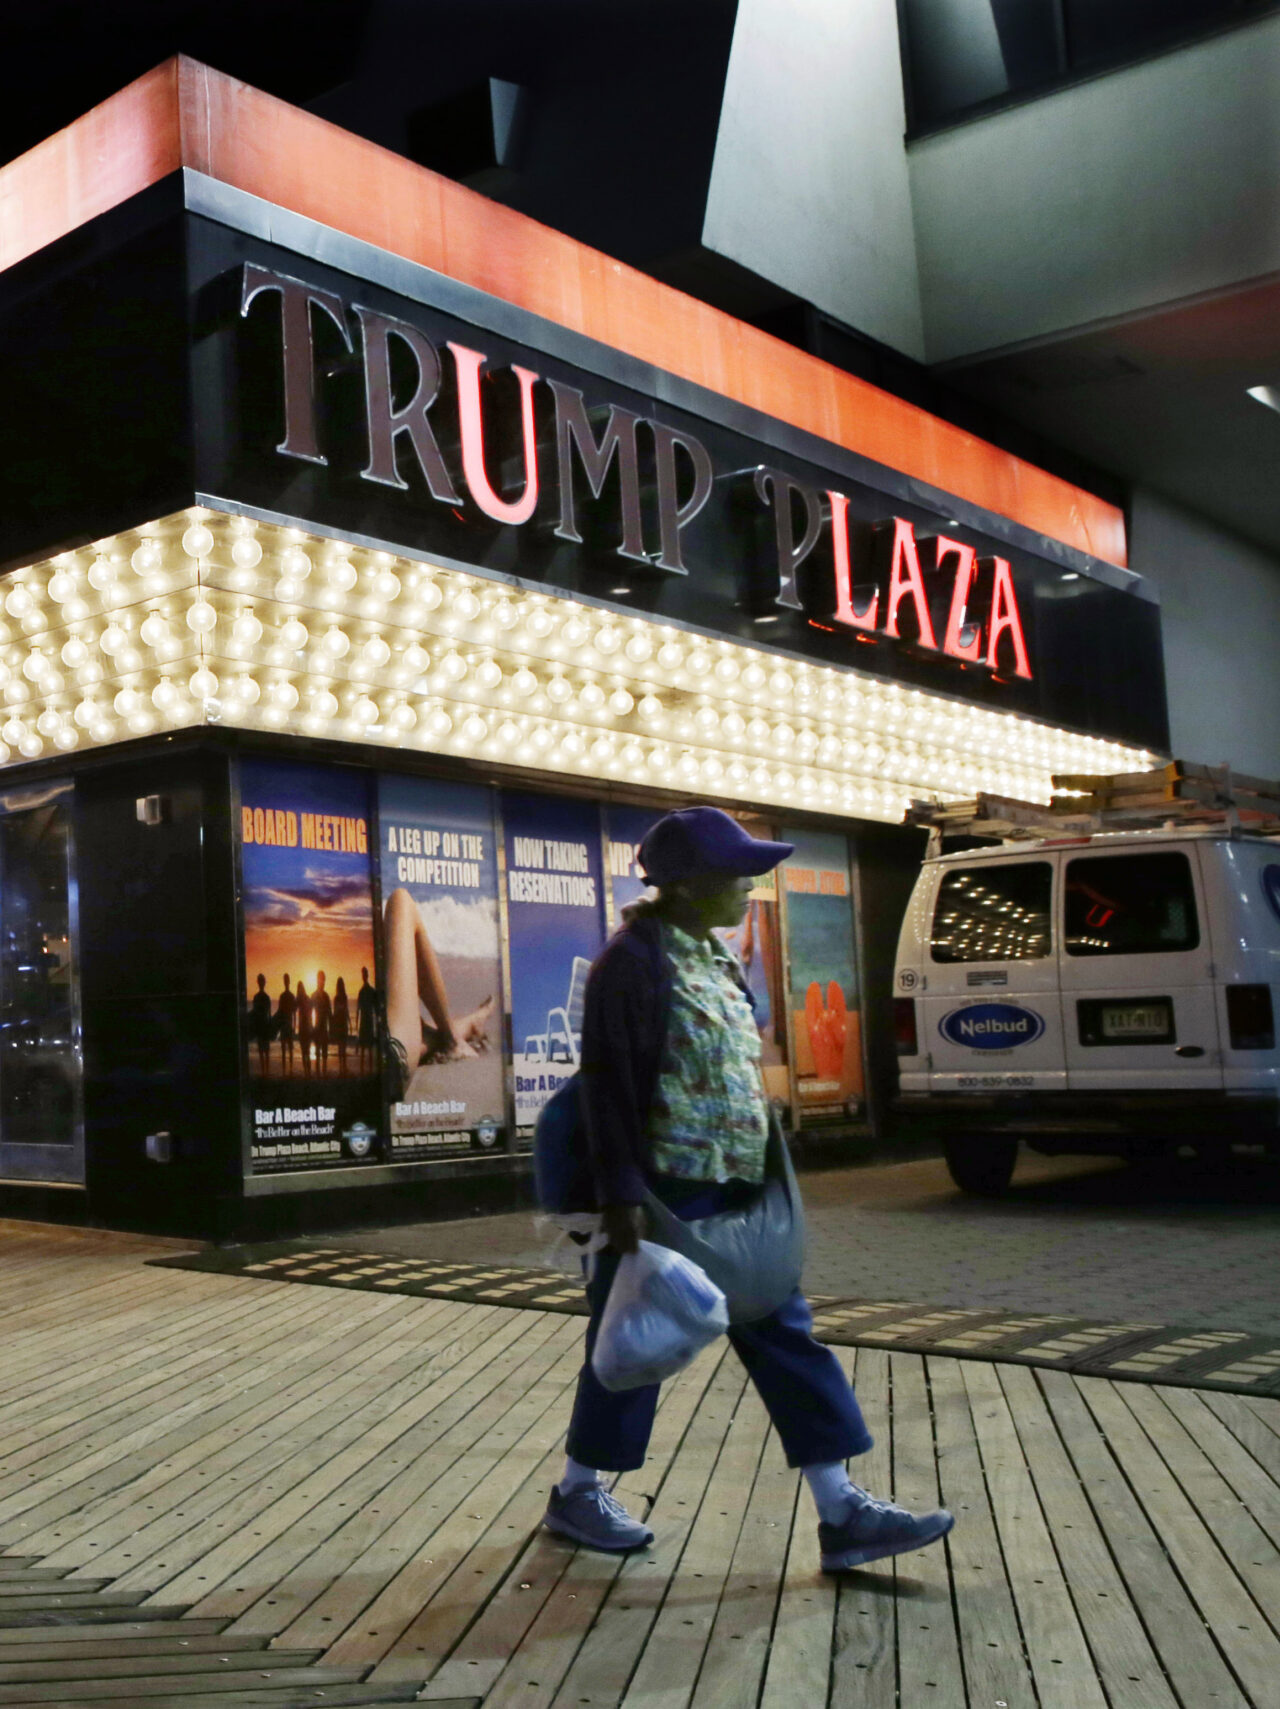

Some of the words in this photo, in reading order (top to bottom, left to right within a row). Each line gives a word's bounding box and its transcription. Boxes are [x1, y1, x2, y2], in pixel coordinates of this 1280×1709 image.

[240, 261, 712, 576] TRUMP
[754, 464, 1032, 680] PLAZA
[242, 806, 298, 847] BOARD
[301, 812, 367, 854] MEETING
[388, 826, 397, 852] A
[399, 828, 421, 854] LEG
[423, 830, 440, 856] UP
[442, 832, 459, 858] ON
[461, 834, 483, 860] THE
[514, 836, 544, 869] NOW
[545, 840, 589, 873] TAKING
[608, 841, 634, 876] VIP
[398, 856, 480, 888] COMPETITION
[509, 870, 596, 907] RESERVATIONS
[900, 973, 915, 987] 19
[960, 1018, 1028, 1037] Nelbud
[516, 1075, 536, 1092] Bar
[539, 1074, 546, 1091] A
[255, 1109, 274, 1124] Bar
[275, 1108, 283, 1123] A
[284, 1106, 317, 1123] Beach
[317, 1106, 336, 1121] Bar
[395, 1102, 411, 1116] Bar
[413, 1101, 420, 1115] A
[420, 1100, 450, 1115] Beach
[450, 1100, 466, 1113] Bar
[267, 1125, 290, 1138] Better
[300, 1124, 312, 1135] the
